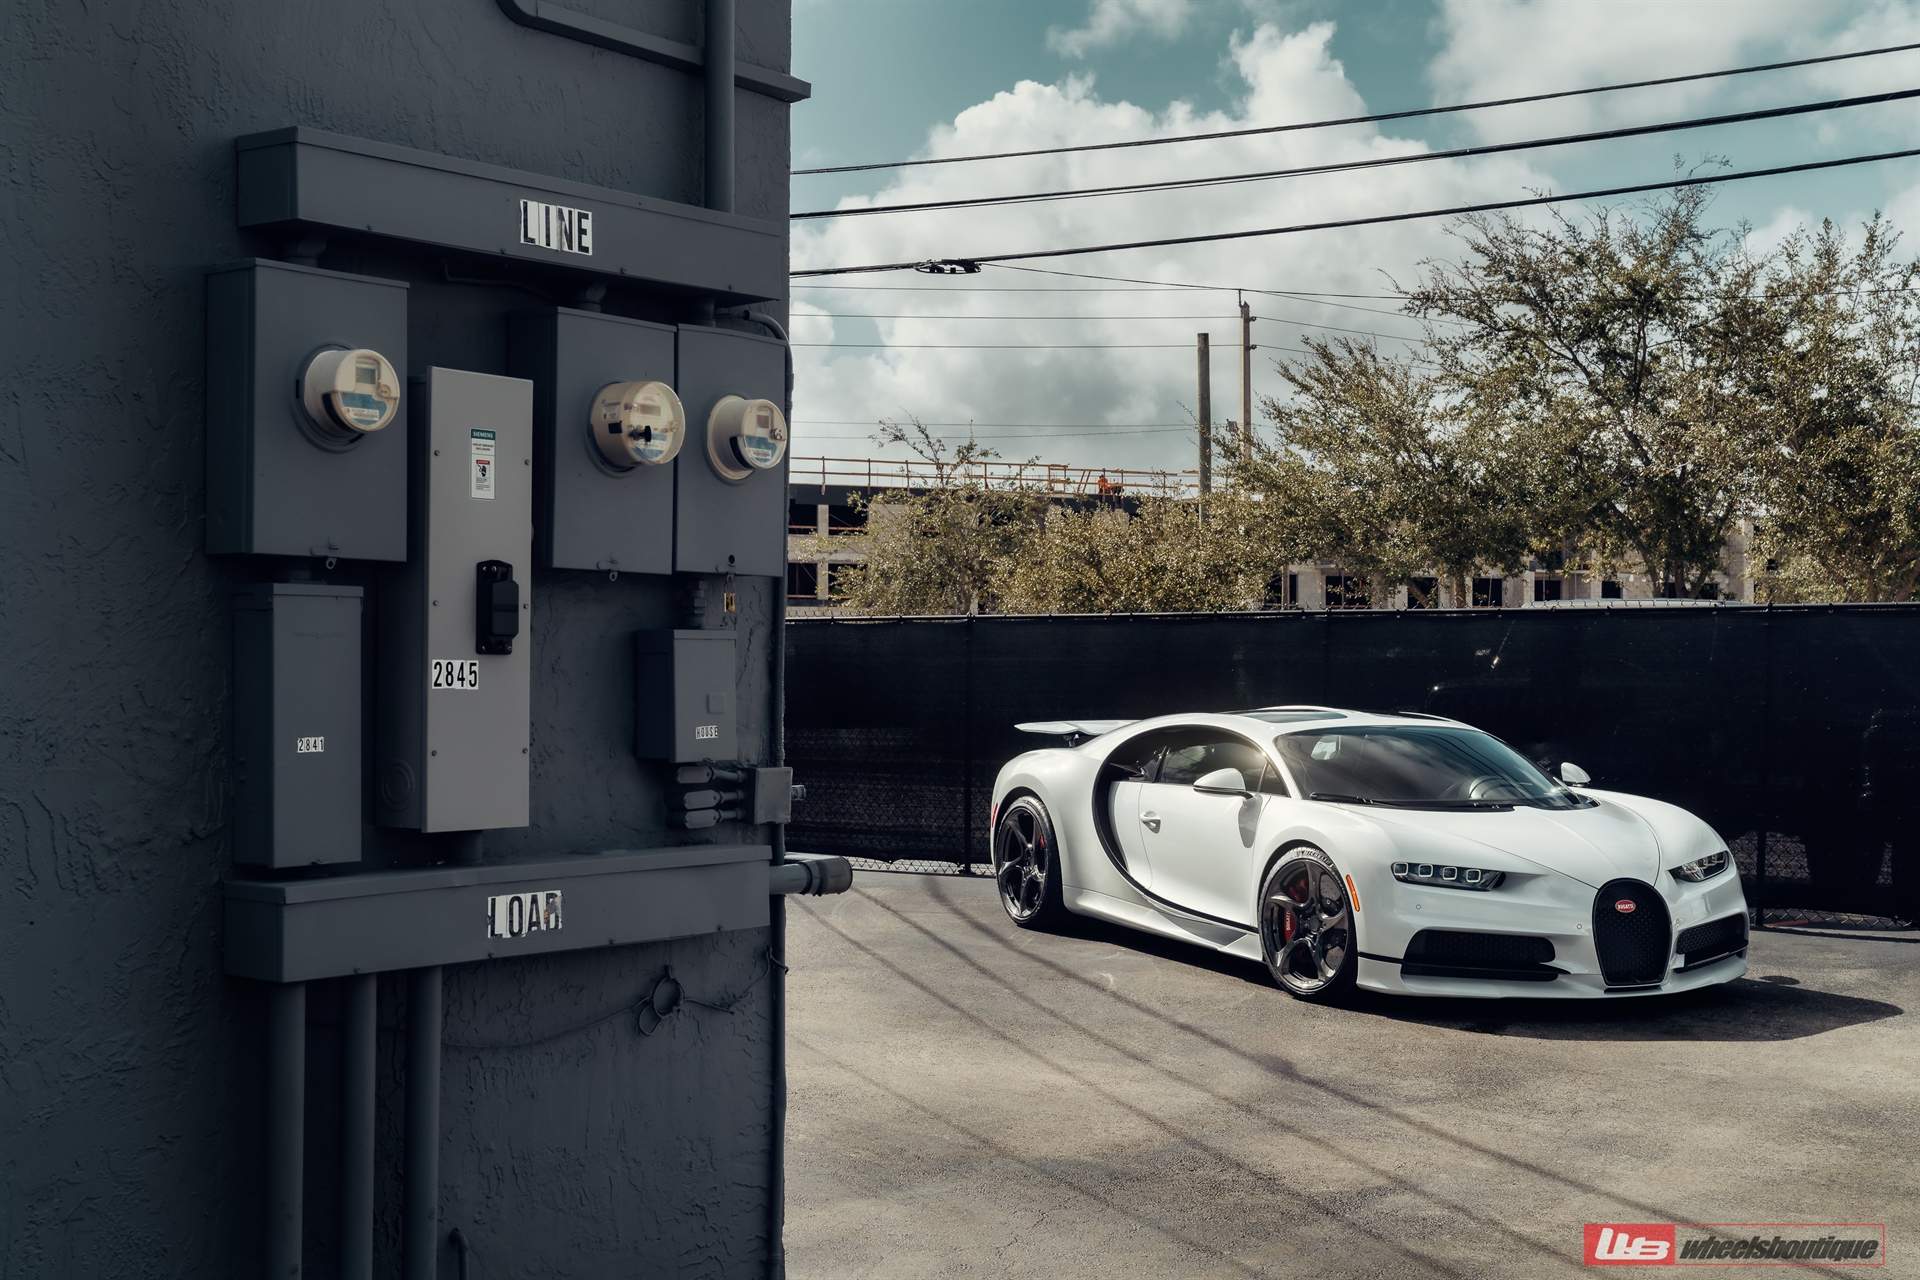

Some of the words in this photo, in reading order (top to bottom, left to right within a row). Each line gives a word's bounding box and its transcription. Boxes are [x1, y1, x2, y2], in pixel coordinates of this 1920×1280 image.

[522, 200, 590, 254] LINE
[433, 661, 477, 687] 2845
[299, 739, 323, 751] 2841
[696, 727, 718, 738] HOUSE
[491, 893, 560, 937] LOAD
